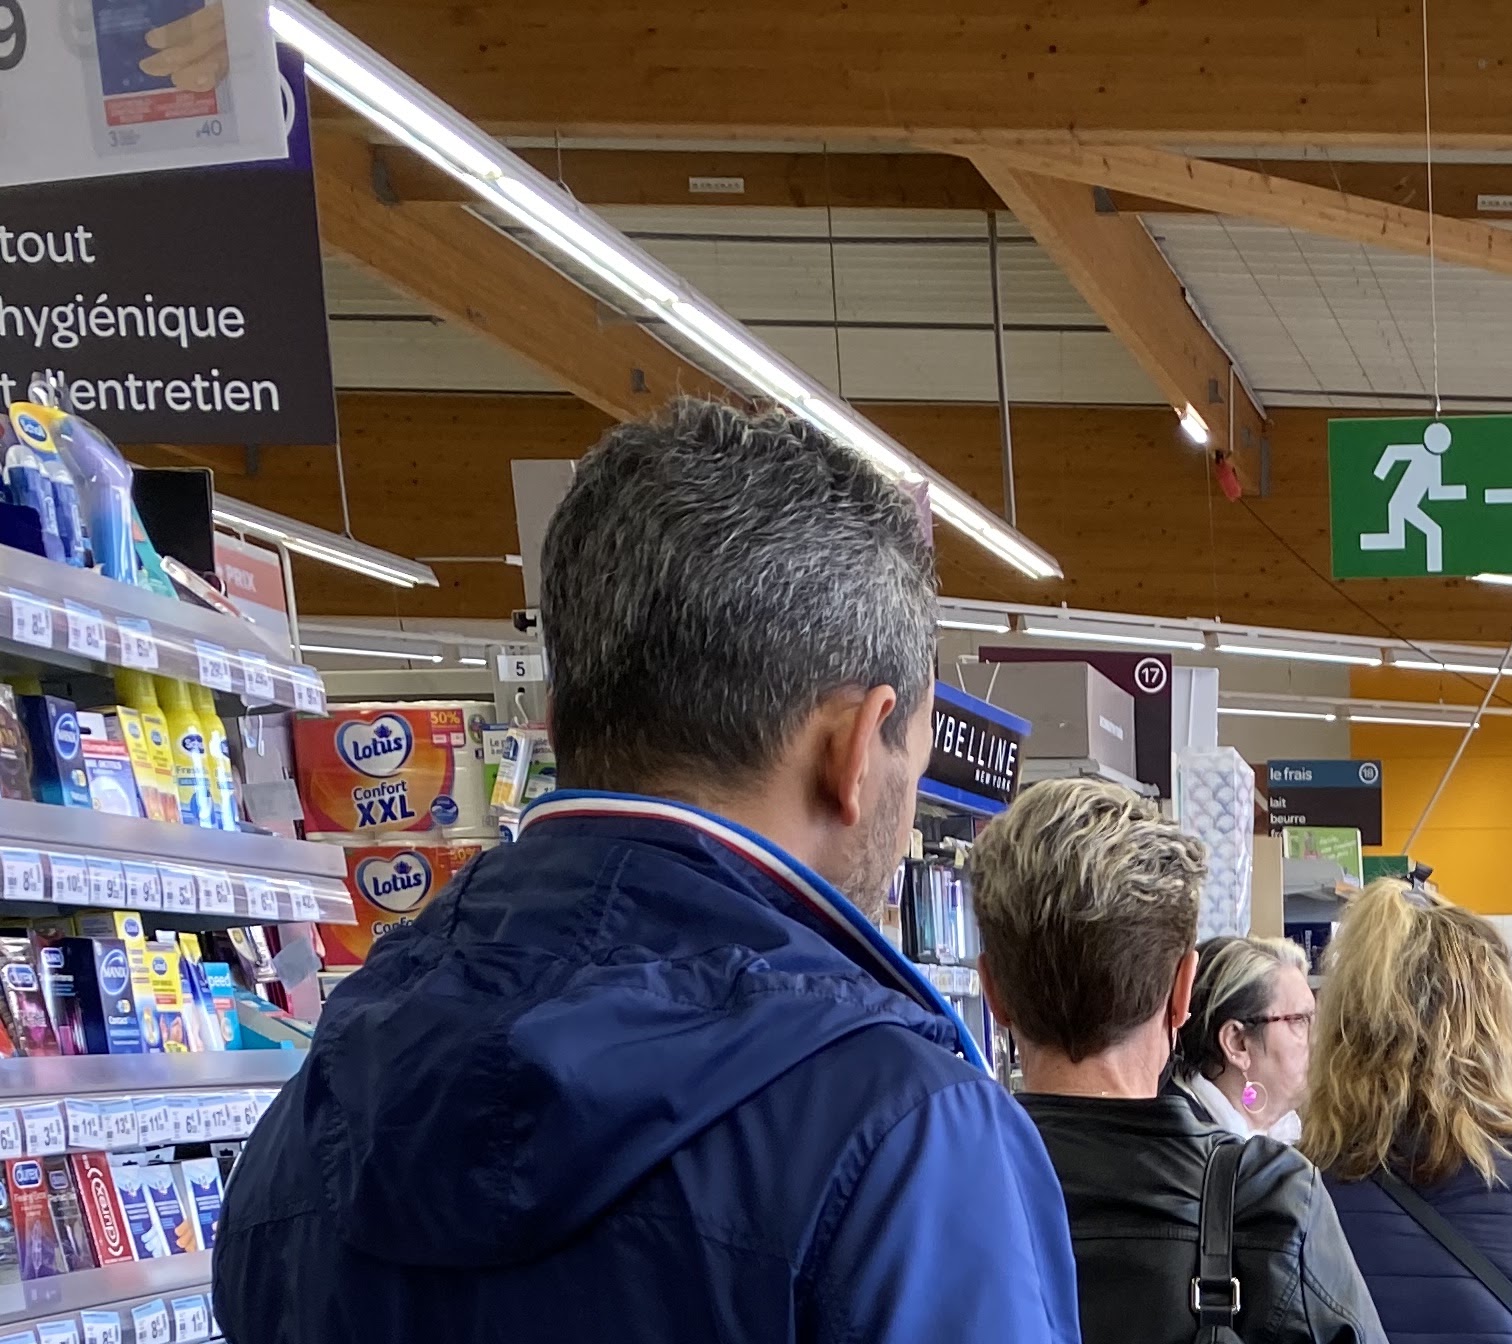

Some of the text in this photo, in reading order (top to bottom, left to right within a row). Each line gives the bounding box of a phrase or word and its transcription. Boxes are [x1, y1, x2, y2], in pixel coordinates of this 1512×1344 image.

[0, 294, 245, 348] hygiénique
[515, 661, 526, 678] 5
[1141, 666, 1161, 685] 17
[935, 711, 1017, 776] YBELLINE
[975, 769, 1011, 792] NEW YORK
[1270, 767, 1282, 781] le
[1283, 767, 1313, 781] frais
[354, 781, 408, 802] Confort
[356, 794, 415, 827] XXL
[1270, 797, 1286, 808] lait
[1270, 813, 1306, 824] beurre
